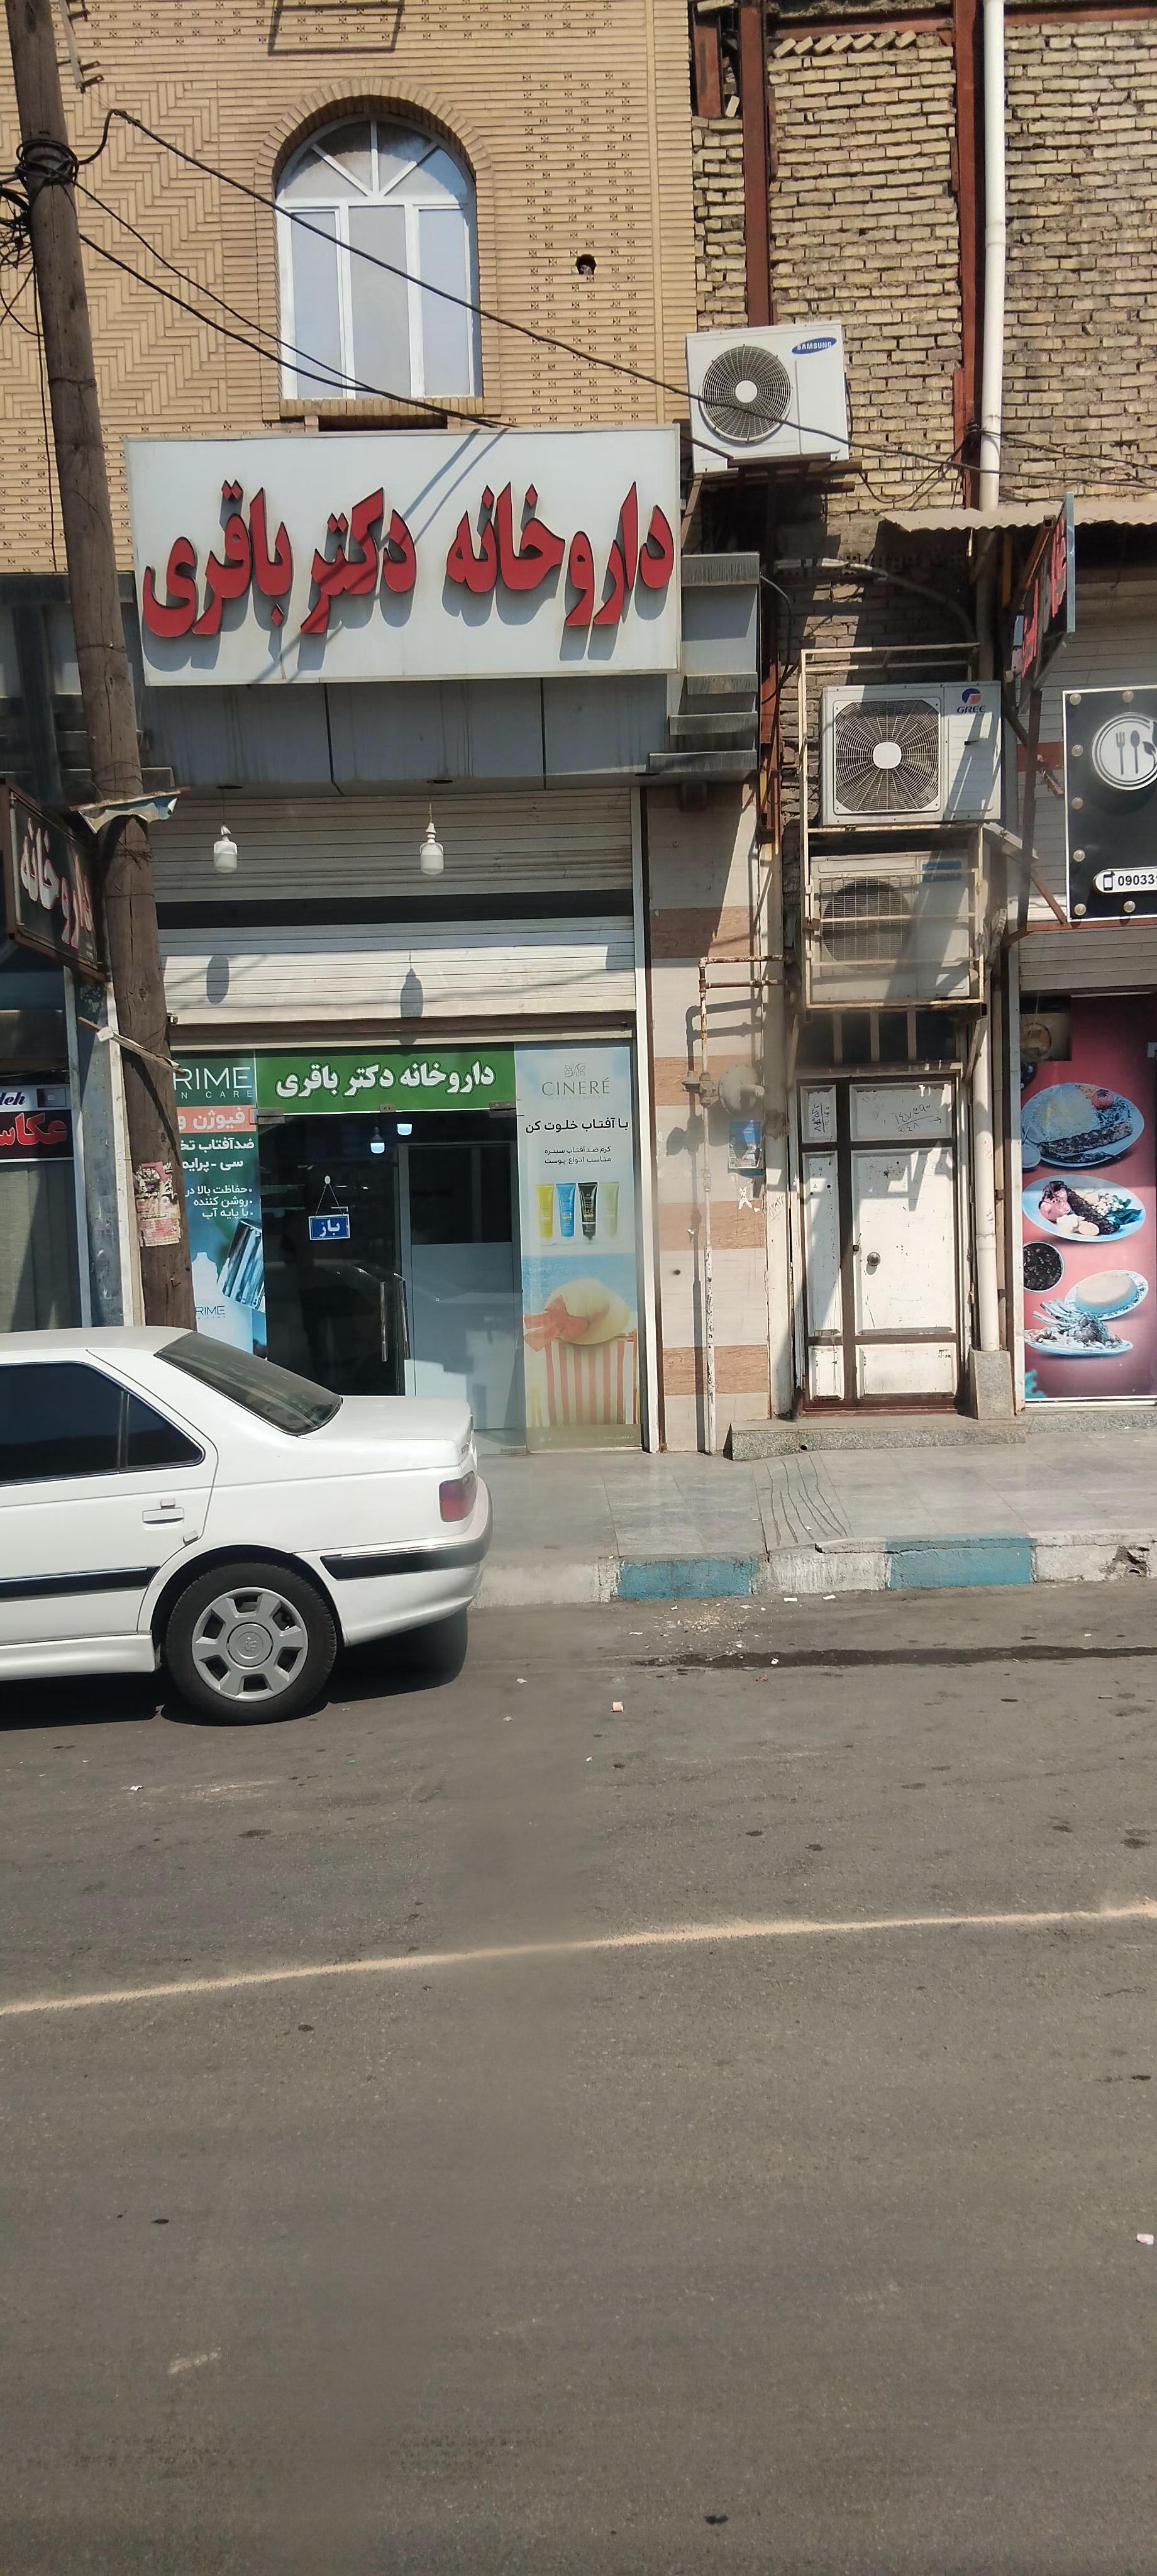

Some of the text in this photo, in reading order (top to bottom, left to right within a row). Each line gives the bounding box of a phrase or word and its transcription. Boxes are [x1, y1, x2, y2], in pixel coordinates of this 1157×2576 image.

[797, 341, 832, 350] SAMSUNG
[143, 479, 675, 638] داروخانه دکتر باقری
[956, 705, 987, 714] GREE
[21, 818, 92, 949] داروخانه
[1117, 874, 1157, 886] 09033
[173, 1067, 252, 1091] RIME
[277, 1061, 495, 1097] داروخانه دکتر باقری
[541, 1077, 610, 1096] CINERÉ
[206, 1091, 253, 1099] CARE
[192, 1107, 245, 1130] فیوژن
[0, 1113, 68, 1145] عکاس
[526, 1117, 628, 1133] با آفتاب خلوت کن
[180, 1140, 196, 1151] تخ
[566, 1146, 585, 1155] آفتاب
[220, 1160, 244, 1171] سی
[568, 1157, 584, 1165] انواع
[586, 1156, 612, 1164] مناسب
[184, 1184, 248, 1197] حفاظت بالا در
[193, 1196, 248, 1208] روشن کننده
[202, 1208, 249, 1219] با پایه آب
[319, 1219, 340, 1238] باز
[195, 1306, 226, 1315] RIME
